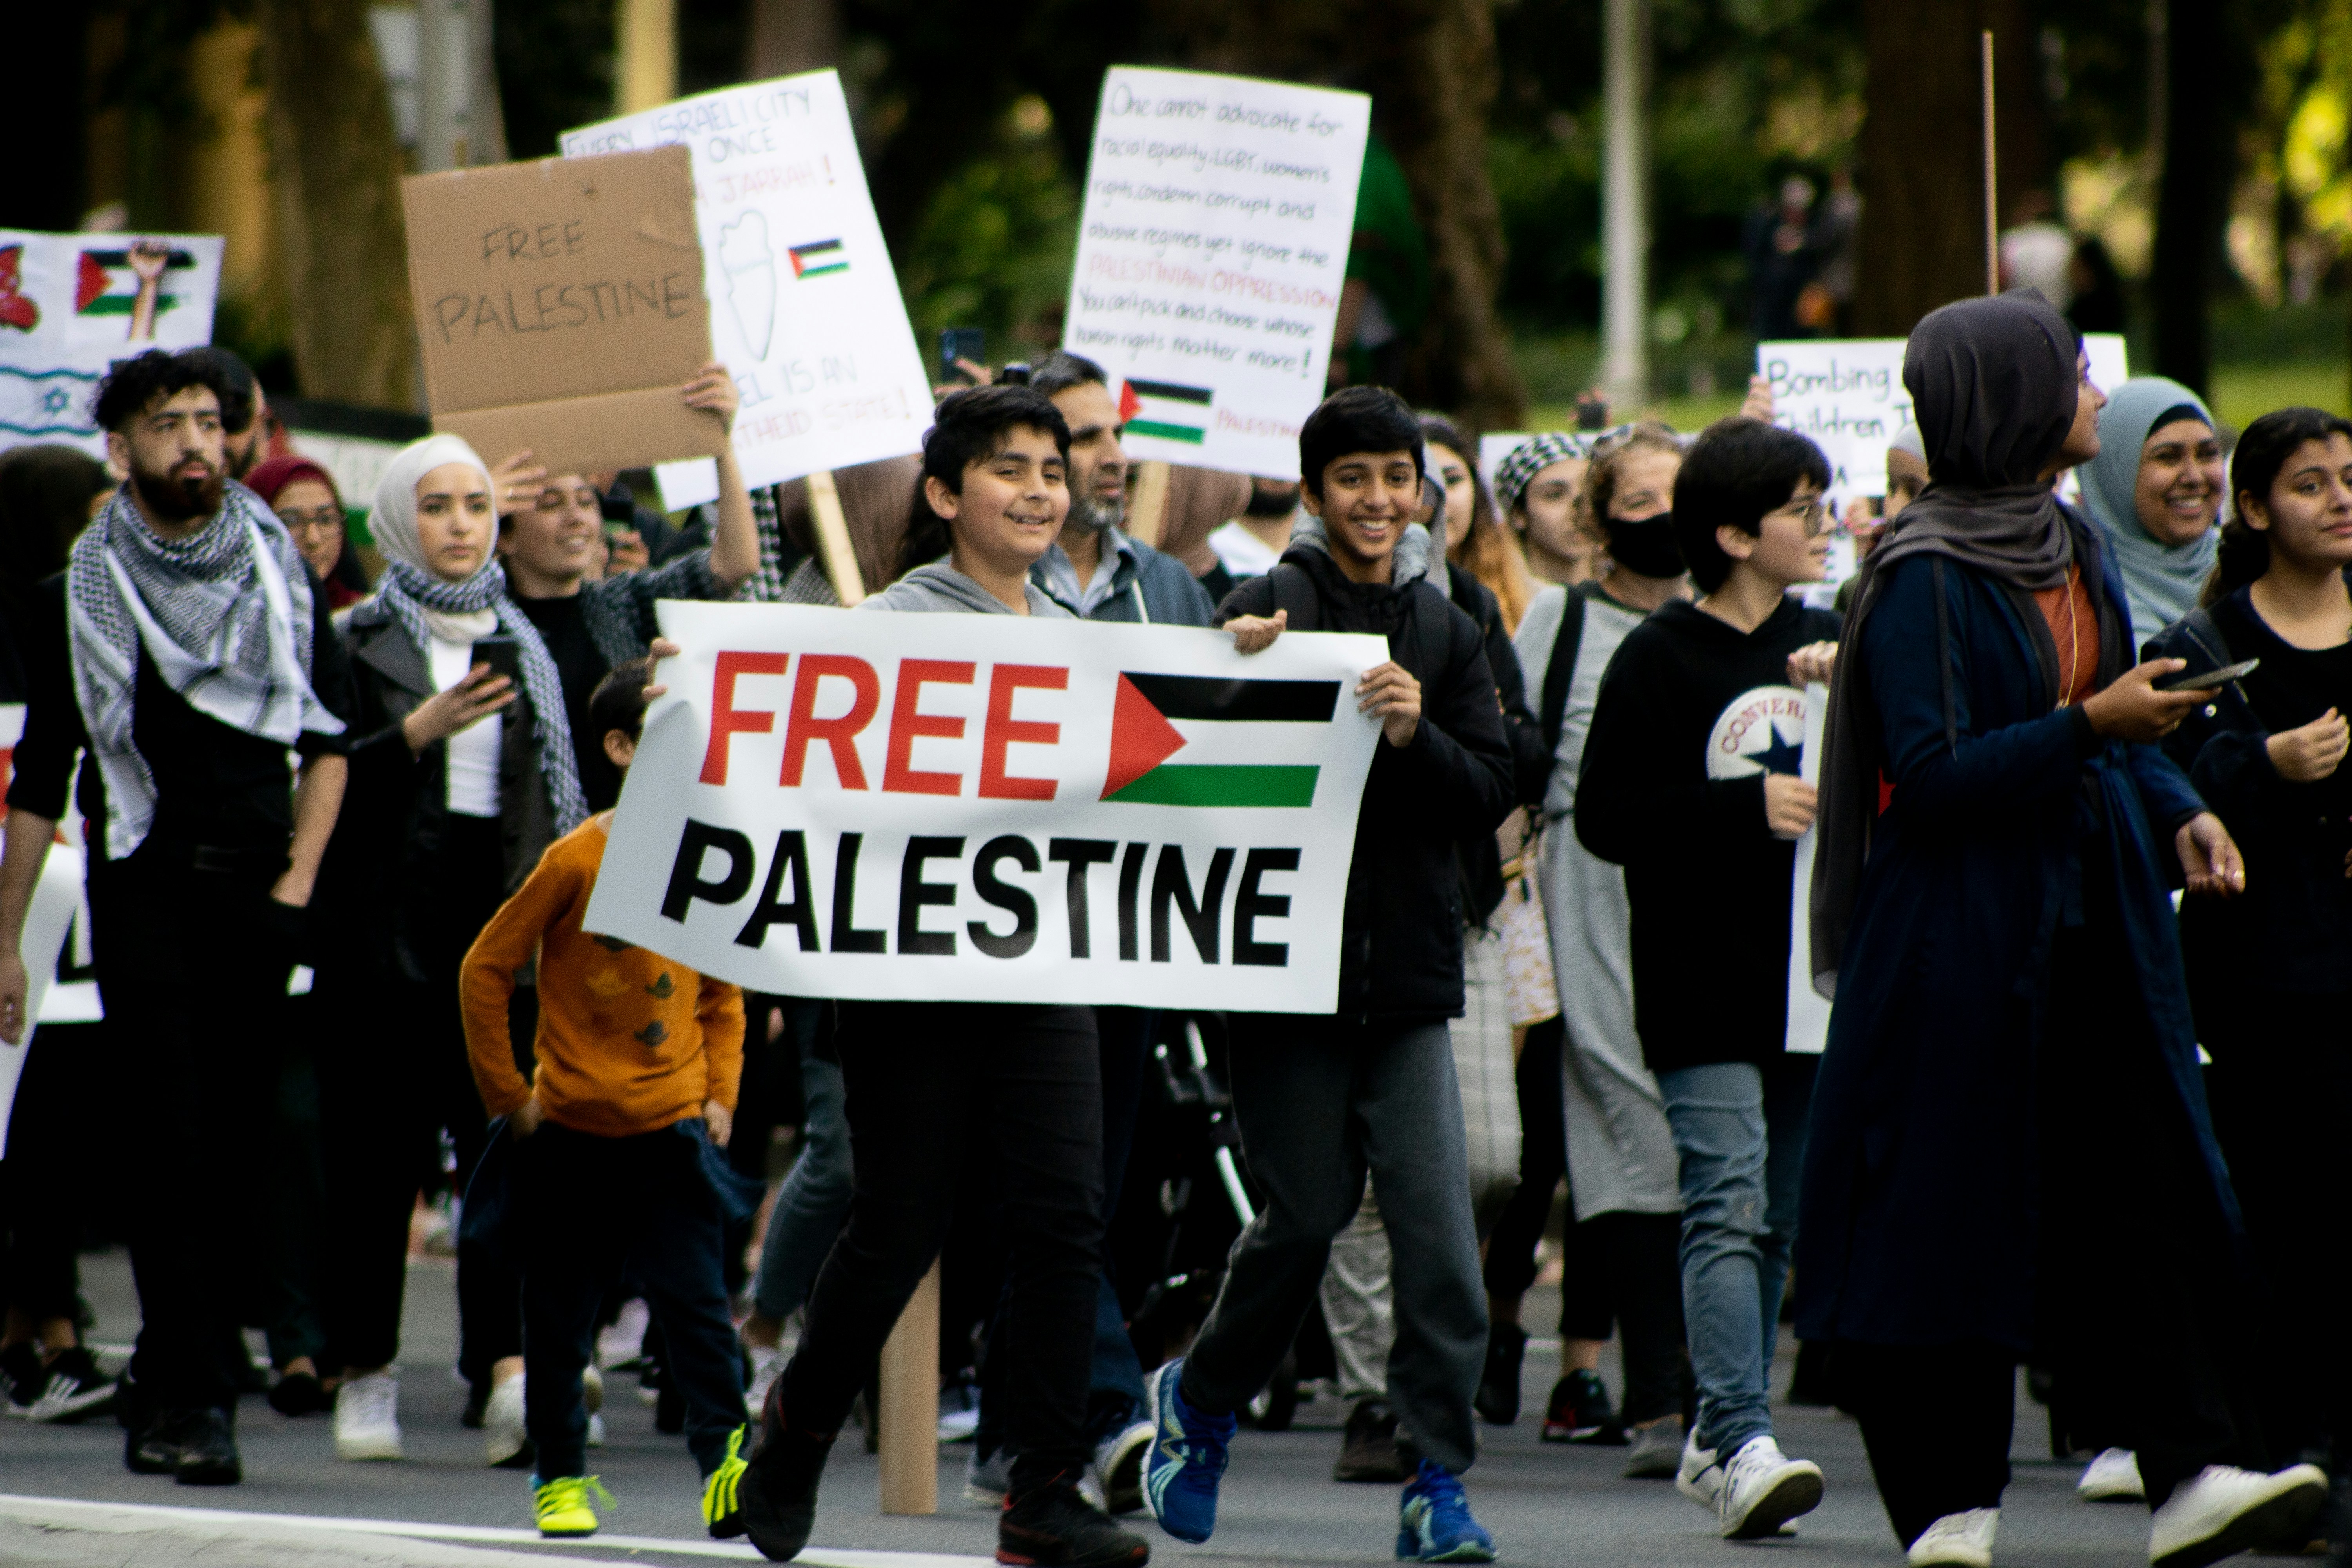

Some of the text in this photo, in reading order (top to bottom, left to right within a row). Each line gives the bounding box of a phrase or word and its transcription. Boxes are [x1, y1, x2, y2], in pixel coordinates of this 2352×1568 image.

[652, 99, 748, 145] ISRAELI
[753, 89, 811, 123] CITY
[1109, 82, 1343, 137] One cannot advocate for
[708, 126, 778, 163] ONCE
[1101, 137, 1146, 158] racial
[1261, 159, 1331, 184] women's
[1204, 189, 1272, 218] corrupt
[1277, 200, 1316, 221] and
[482, 218, 587, 267] FREE
[1142, 225, 1201, 258] regimes
[1204, 231, 1234, 262] yet
[1240, 236, 1292, 271] ignore
[1296, 243, 1329, 268] the
[1089, 253, 1336, 310] PALESTINIAN OPPRESSION
[433, 269, 690, 345] PALESTINE
[1080, 285, 1104, 313] You
[1175, 302, 1206, 323] and
[1207, 305, 1259, 330] choose
[1264, 315, 1315, 338] whose
[1076, 325, 1117, 347] human
[1121, 332, 1164, 361] rights
[820, 353, 858, 385] AN
[1767, 356, 1891, 404] Bombing
[1216, 409, 1303, 440] PALESTIN
[700, 650, 1071, 802] FREE
[659, 818, 1303, 967] PALESTINE
